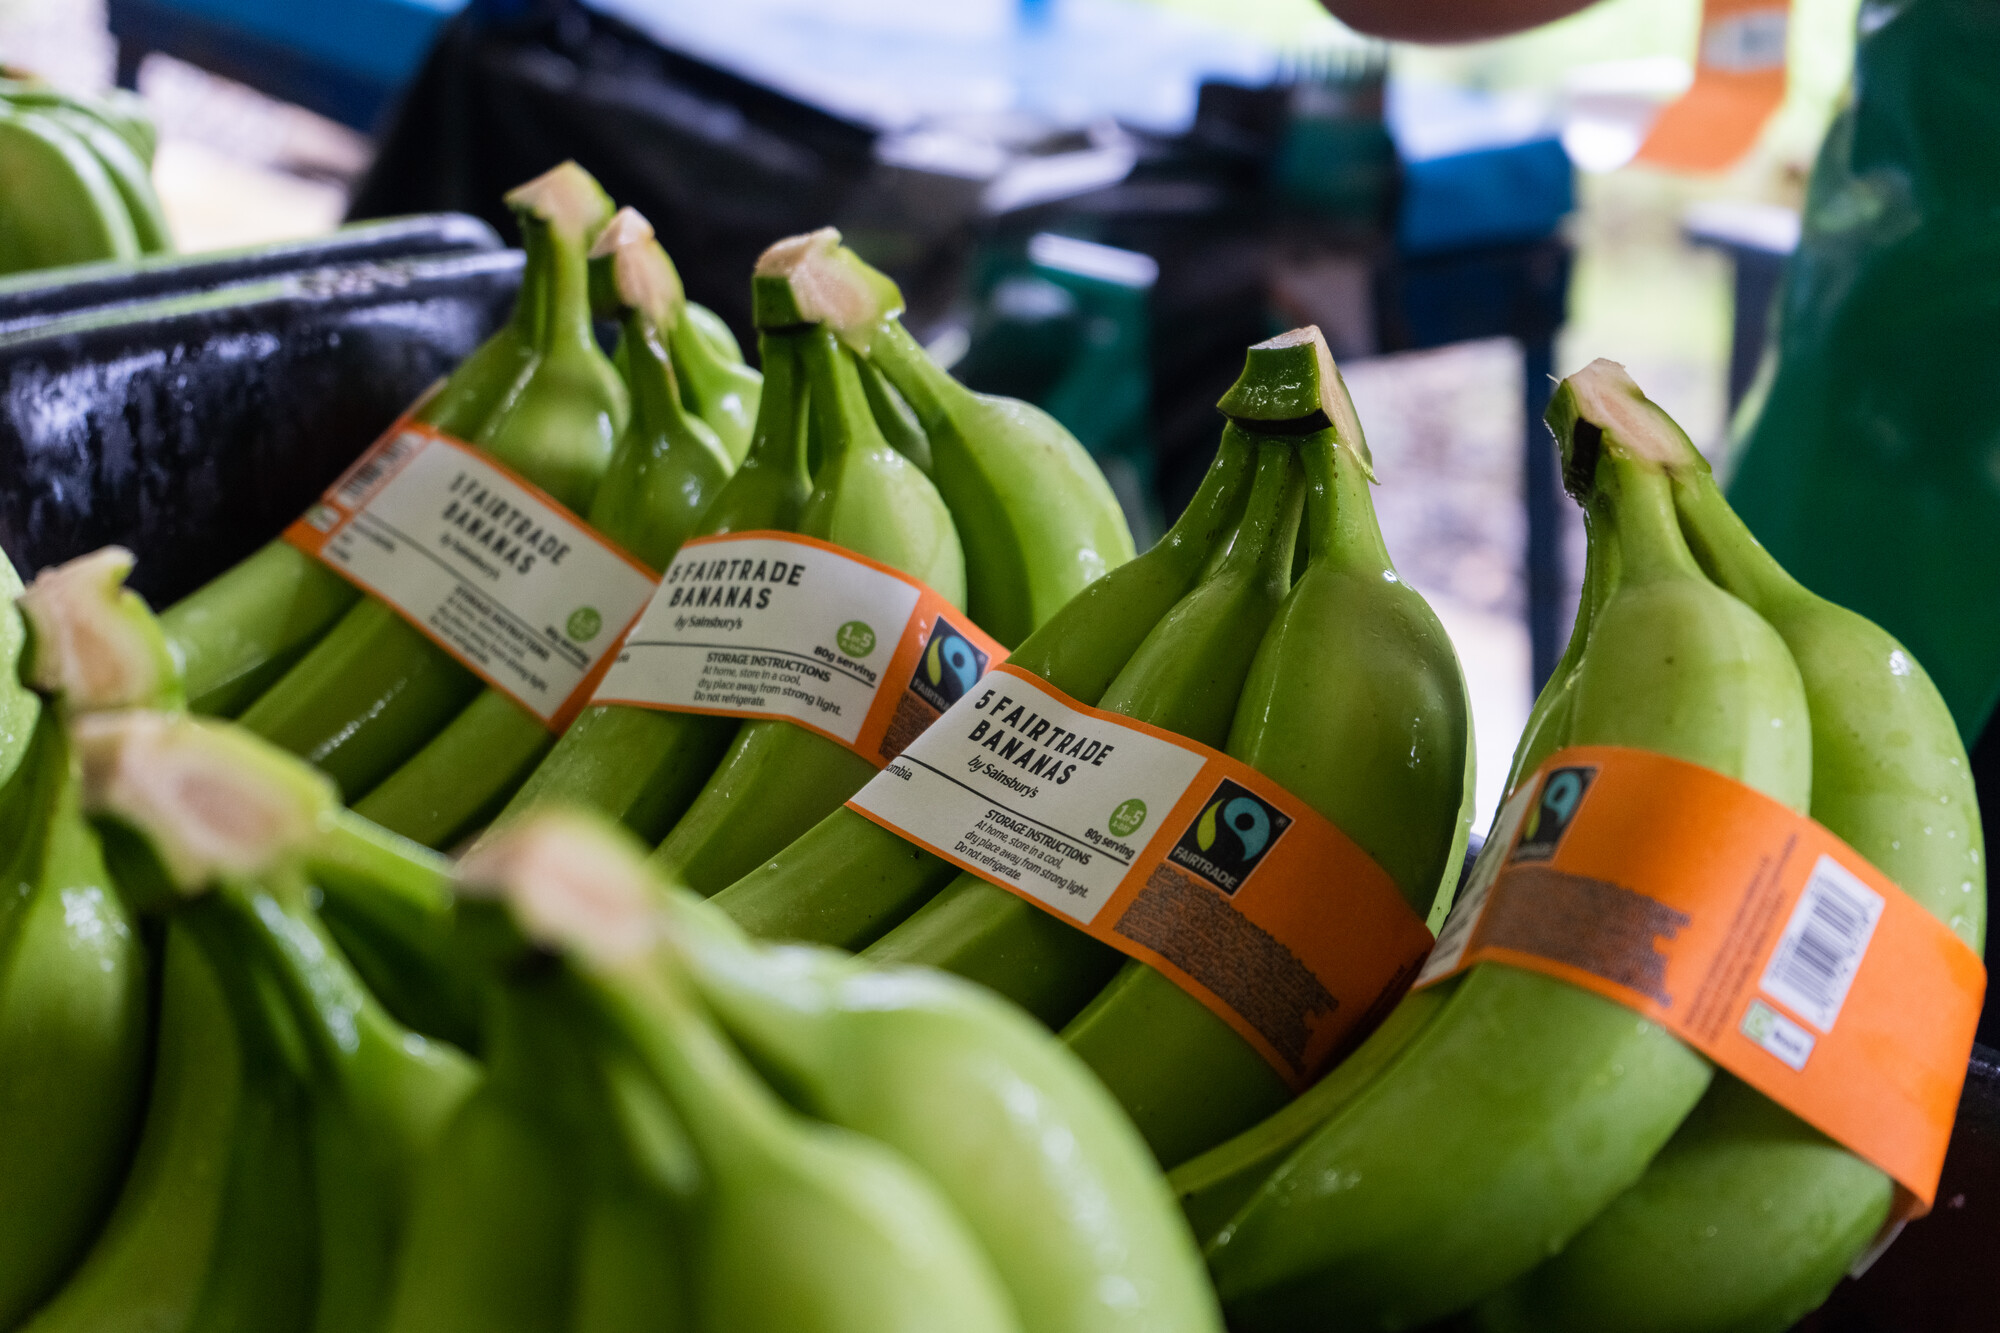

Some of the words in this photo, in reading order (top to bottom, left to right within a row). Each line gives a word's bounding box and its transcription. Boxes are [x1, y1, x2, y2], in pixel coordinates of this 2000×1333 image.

[681, 558, 806, 587] FAIRTRADE
[668, 586, 773, 610] BANANAS
[674, 615, 688, 632] by
[687, 616, 743, 632] Sainsbury's
[706, 652, 749, 666] STORAGE
[750, 654, 832, 683] INSTRUCTIONS
[738, 667, 761, 679] store
[813, 646, 835, 663] 80g
[836, 656, 877, 683] serving
[693, 690, 706, 701] Do
[706, 692, 721, 702] not
[698, 677, 713, 690] dry
[712, 679, 735, 691] place
[735, 682, 759, 694] away
[758, 683, 781, 695] from
[781, 686, 816, 706] strong
[974, 689, 996, 710] 5
[989, 695, 1115, 767] FAIRTRADE
[967, 719, 1077, 785] BANANAS
[967, 754, 984, 773] by
[982, 763, 1039, 799] Sainsbury's
[974, 820, 986, 831] At
[984, 824, 1009, 844] home,
[1008, 837, 1029, 852] store
[1028, 845, 1039, 856] in
[1043, 853, 1064, 870] cool,
[985, 809, 1027, 835] STORAGE
[1024, 827, 1092, 866] INSTRUCTIONS
[1084, 828, 1103, 845] 80g
[1101, 837, 1135, 860] serving
[954, 840, 966, 853] Do
[965, 846, 981, 860] not
[980, 852, 1022, 881] refrigerate.
[964, 830, 979, 846] dry
[977, 835, 1001, 854] place
[999, 851, 1021, 867] away
[1020, 857, 1042, 874] from
[1039, 868, 1069, 890] strong
[1066, 879, 1089, 898] light.
[1172, 846, 1238, 891] FAIRTRADE
